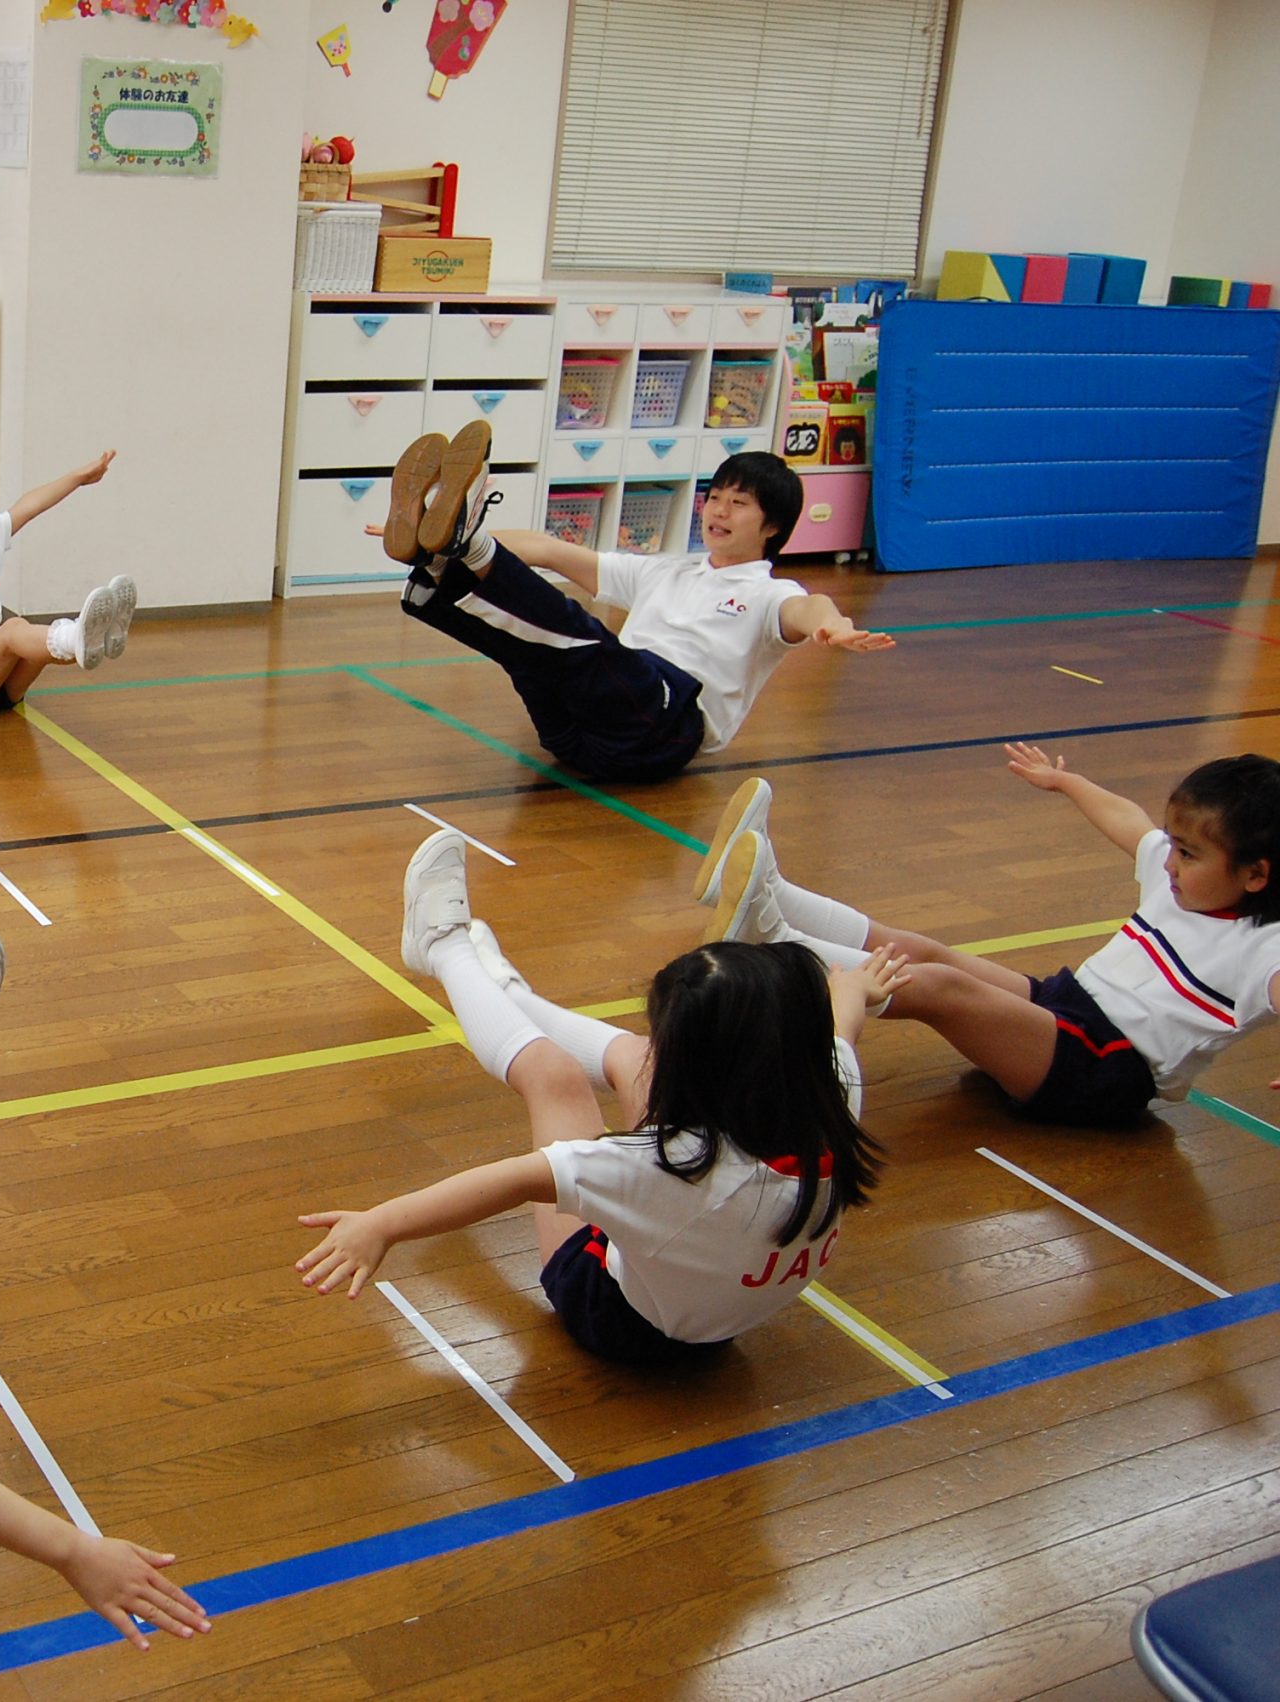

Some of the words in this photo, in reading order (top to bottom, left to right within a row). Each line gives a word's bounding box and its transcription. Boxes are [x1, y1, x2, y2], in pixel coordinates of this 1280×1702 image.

[119, 88, 189, 104] 体験のお友達
[412, 257, 464, 267] JIYUGAKUEN
[422, 266, 454, 275] TSUMIKI
[741, 1228, 838, 1288] JAC
